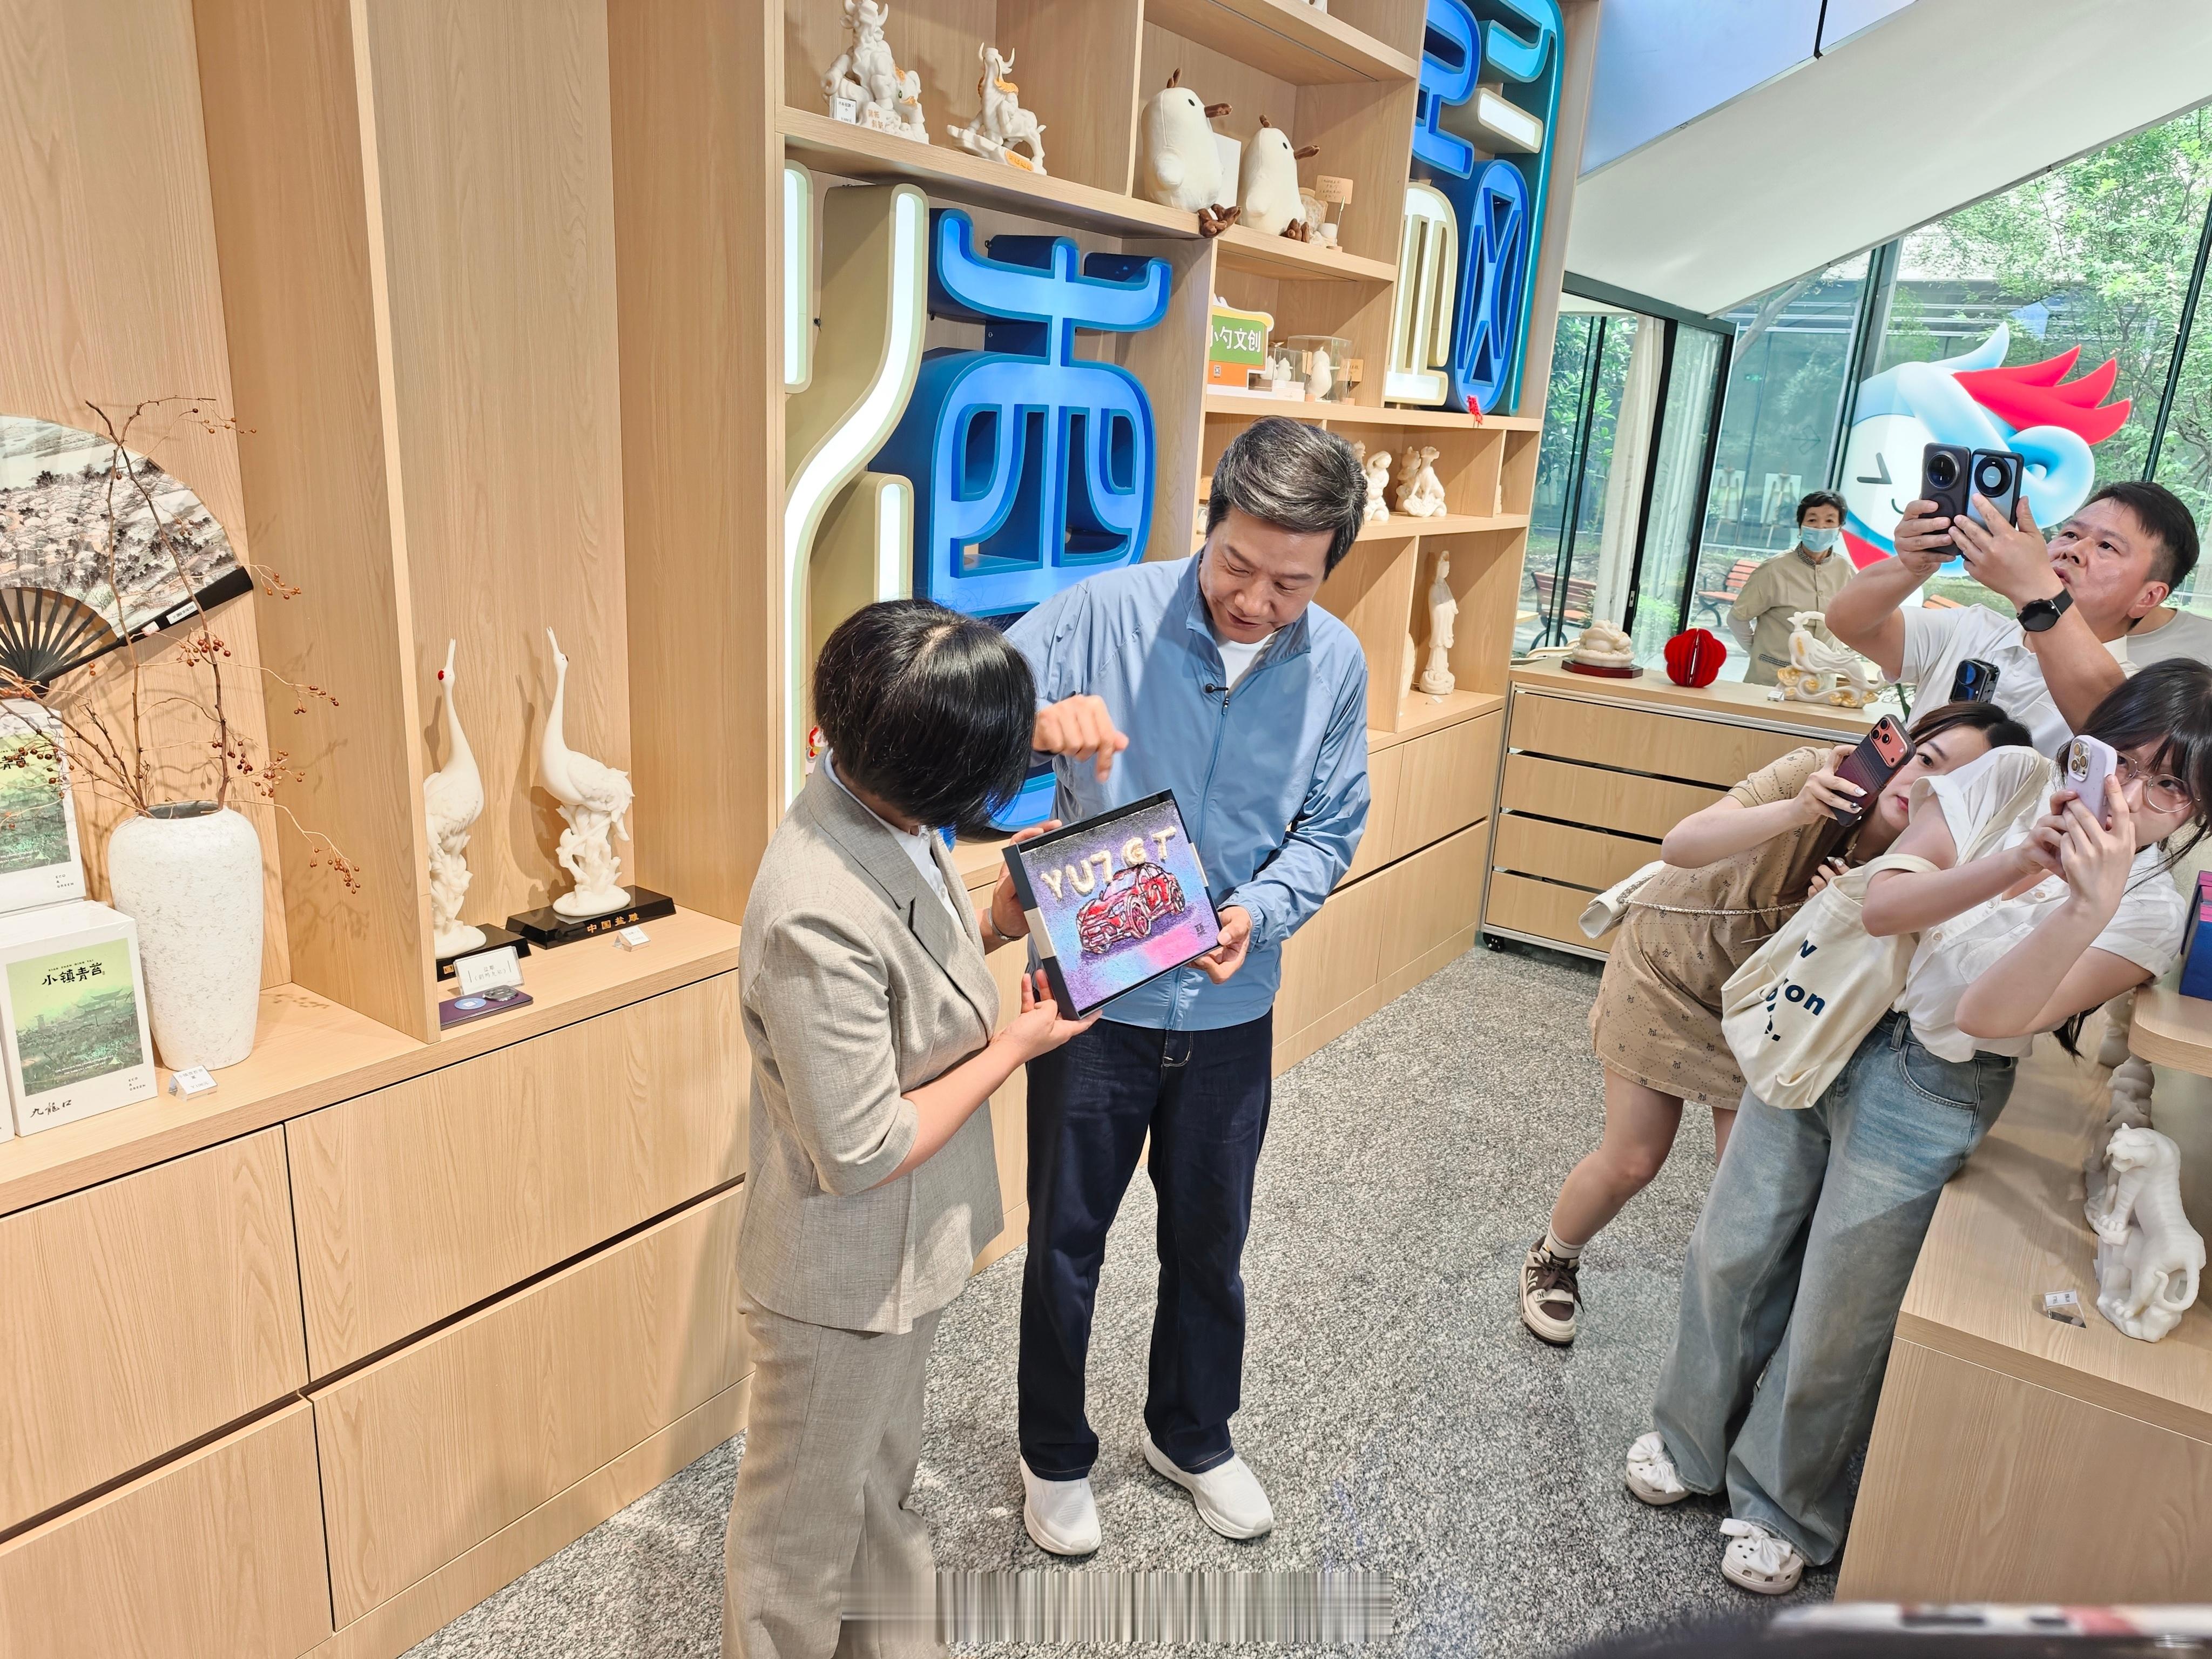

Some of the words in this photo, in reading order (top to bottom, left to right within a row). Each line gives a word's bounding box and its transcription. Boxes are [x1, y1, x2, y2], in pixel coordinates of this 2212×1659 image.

[1210, 325, 1261, 353] 小勺文创
[1041, 850, 1114, 899] YU7
[587, 912, 639, 933] 中国盐雕
[42, 962, 102, 986] 小镇青苔
